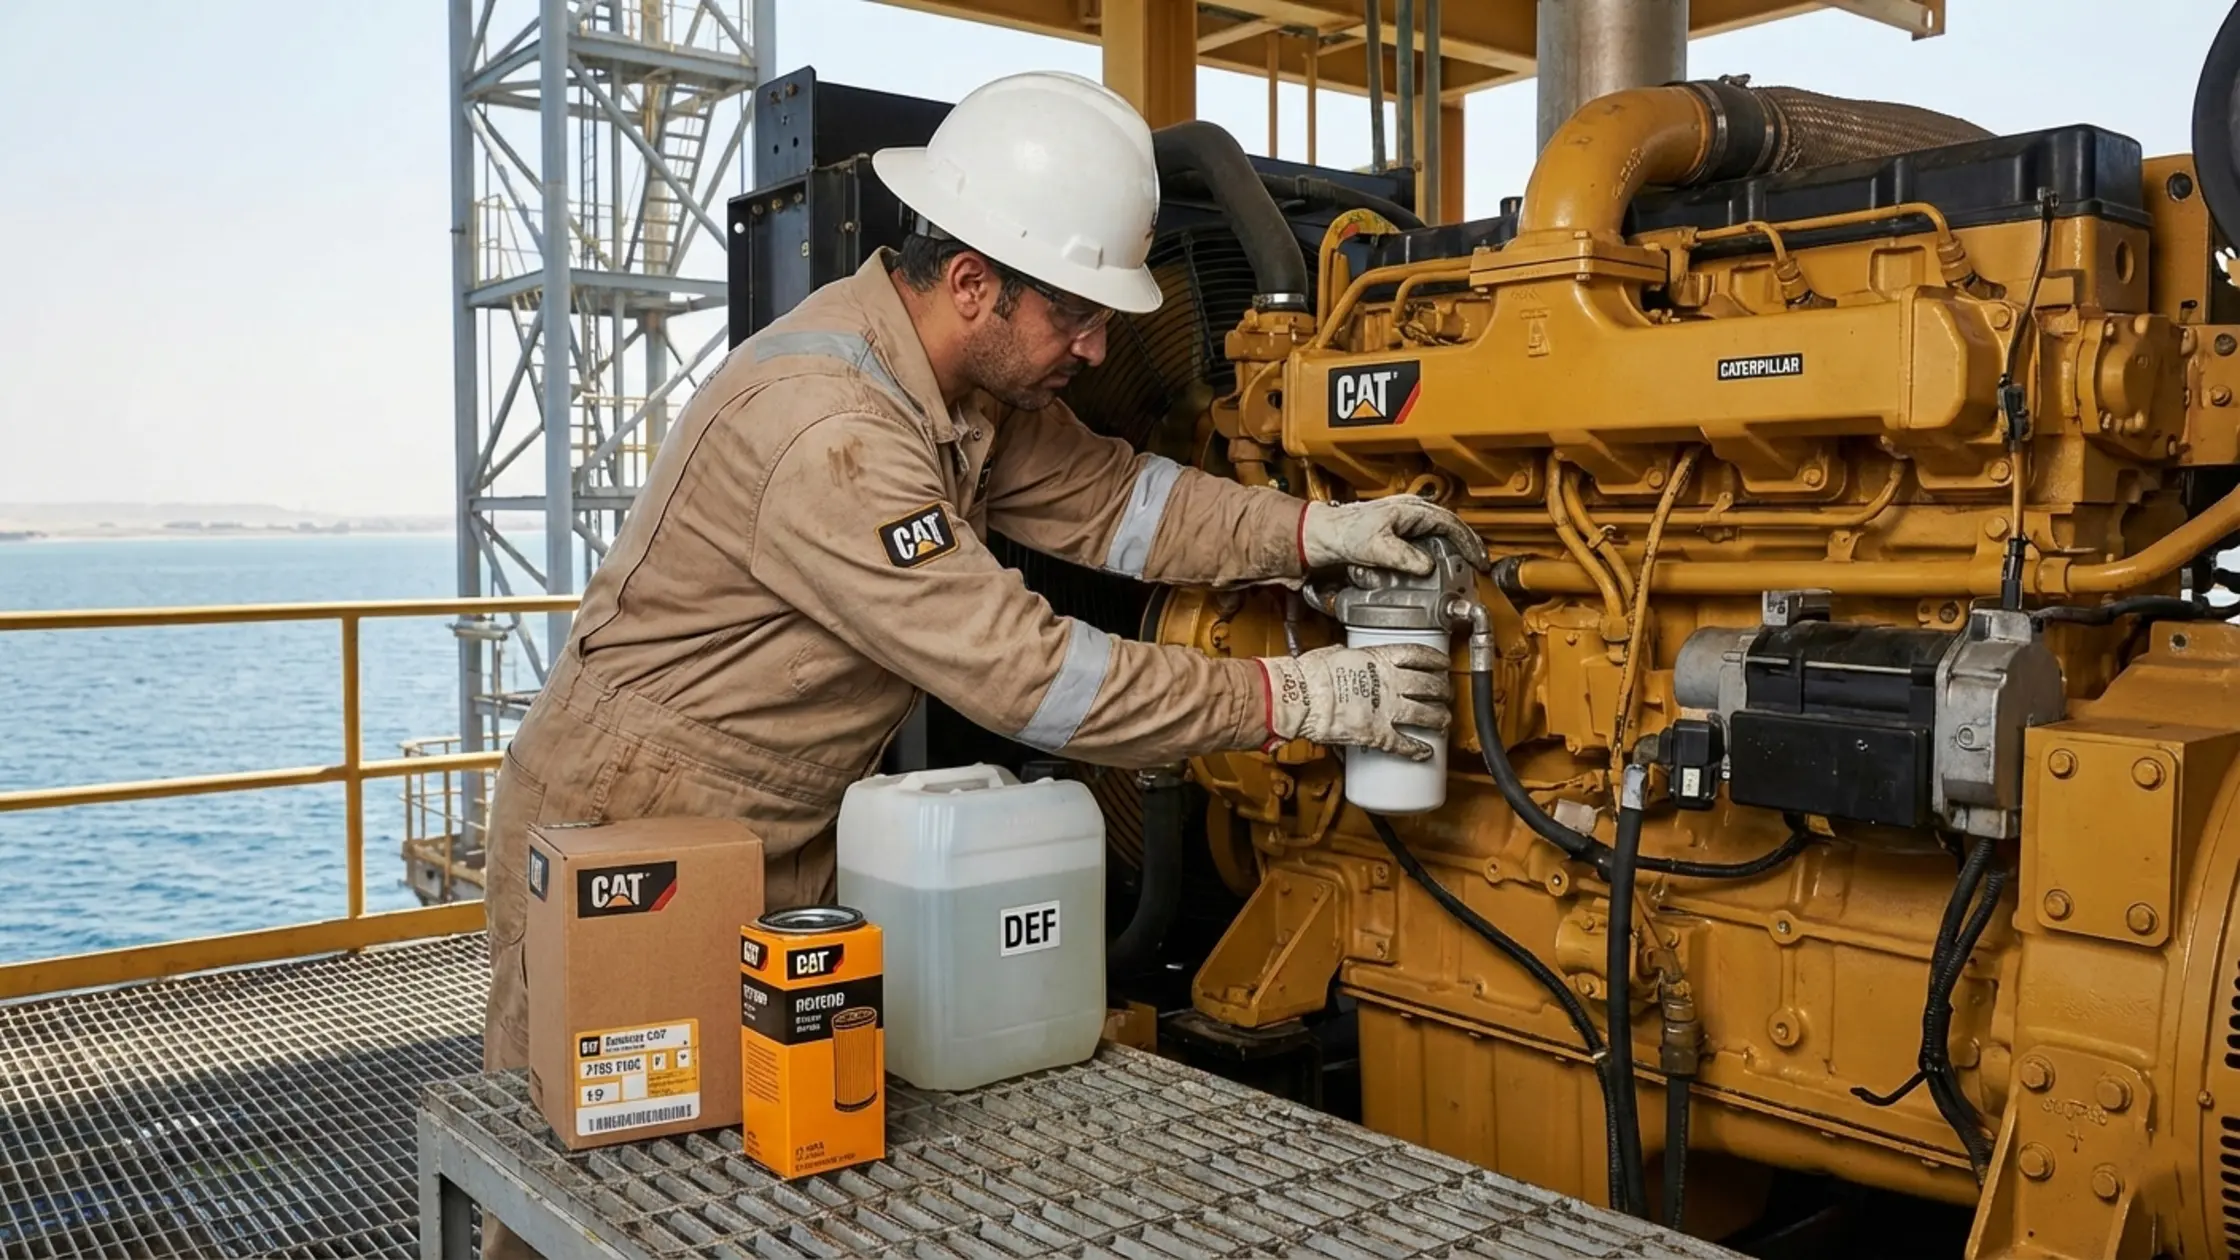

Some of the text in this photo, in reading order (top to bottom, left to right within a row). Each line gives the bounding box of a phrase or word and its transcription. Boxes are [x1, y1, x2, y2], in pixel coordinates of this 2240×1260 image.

[1720, 357, 1800, 377] CATERPILLAR
[1337, 371, 1391, 420] CAT
[893, 512, 944, 560] CAT
[591, 872, 643, 908] CAT
[1005, 908, 1056, 949] DEF
